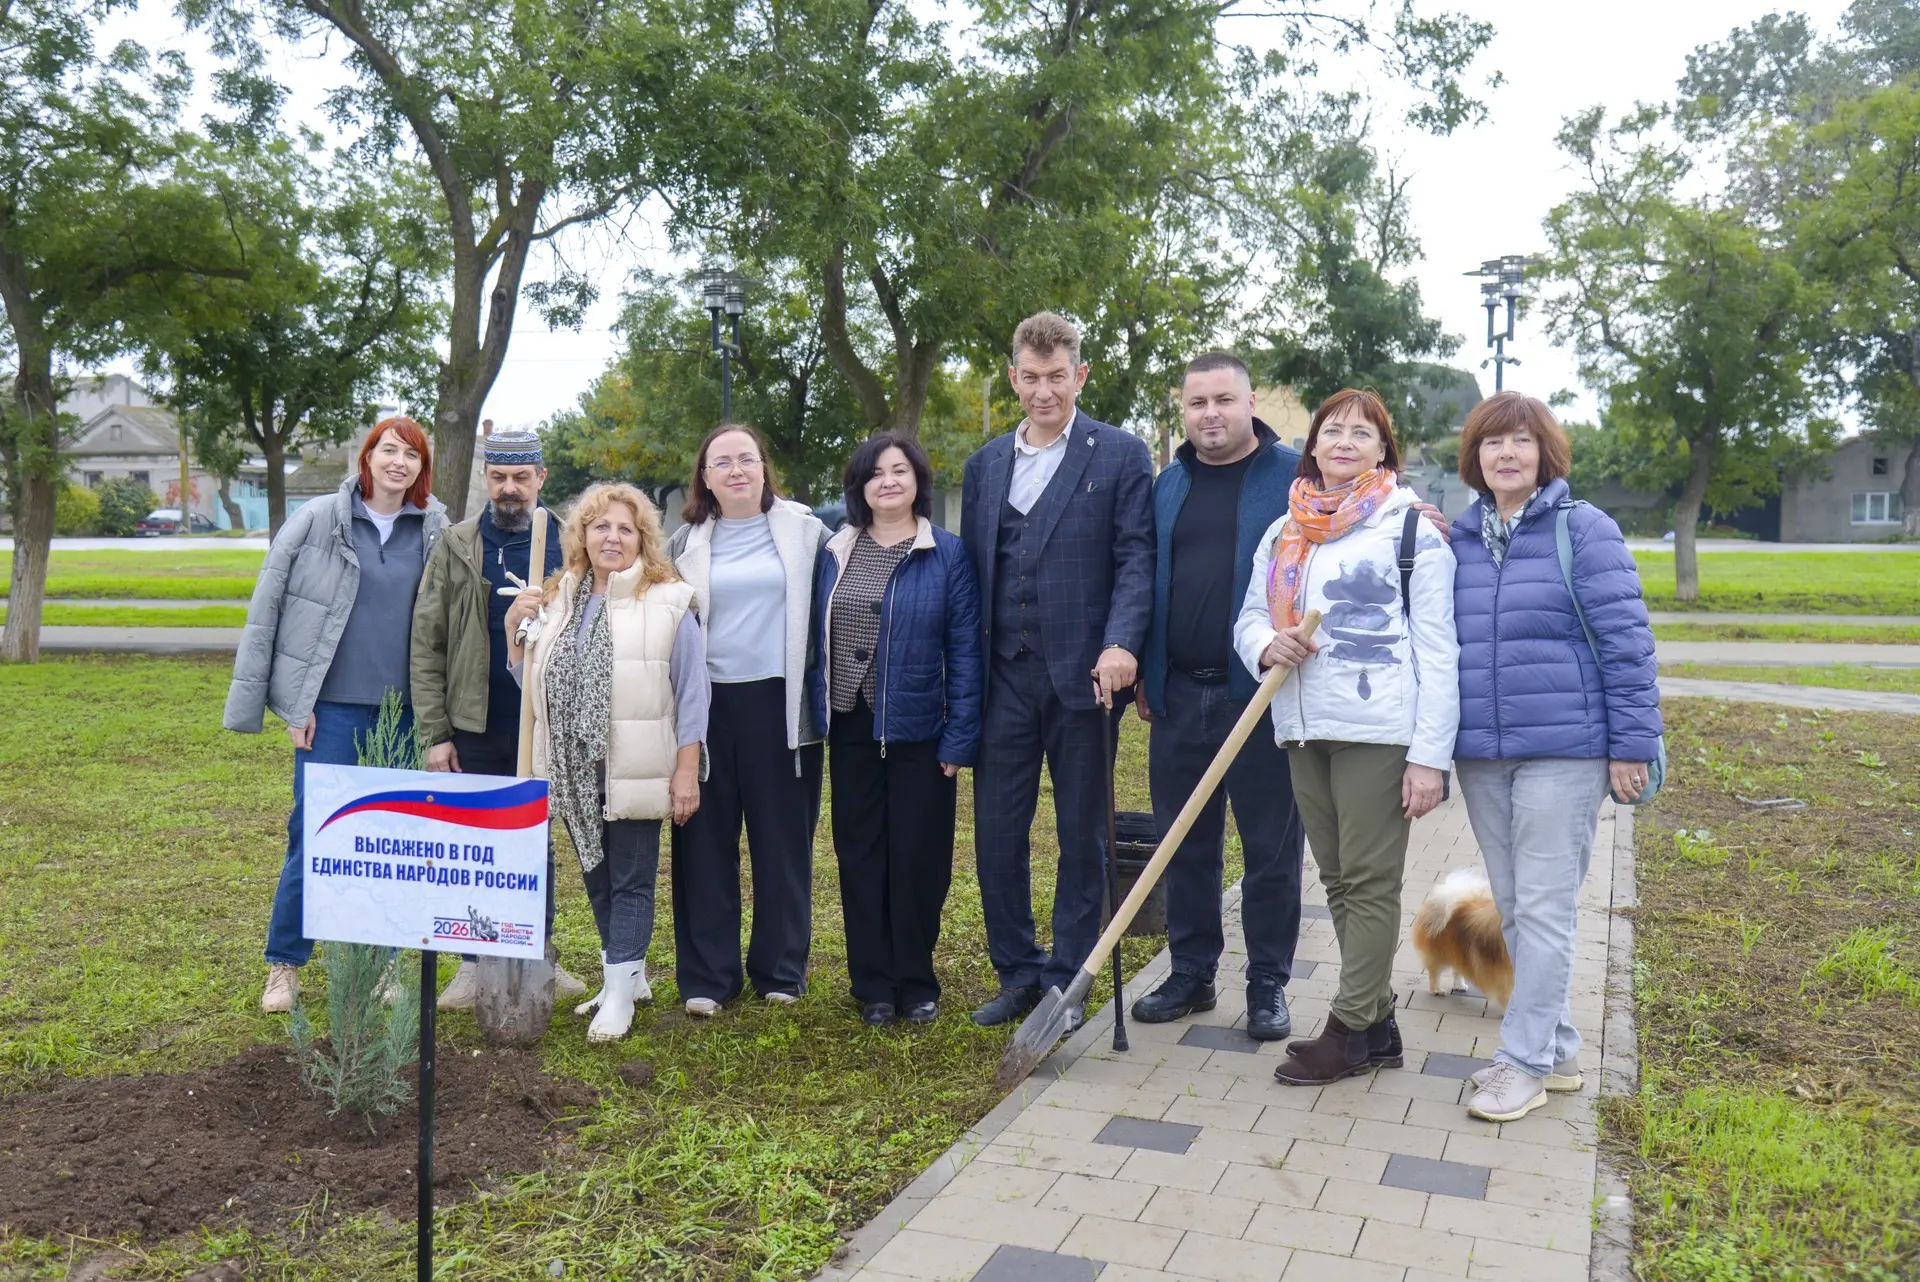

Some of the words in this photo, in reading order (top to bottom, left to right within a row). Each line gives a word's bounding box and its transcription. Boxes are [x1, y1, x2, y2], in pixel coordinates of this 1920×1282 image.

[355, 836, 445, 858] ВЫСАЖЕНО
[449, 844, 459, 860] В
[463, 844, 495, 865] ГОД
[312, 857, 393, 880] ЕДИНСТВА
[396, 864, 470, 887] НАРОДОВ
[475, 872, 538, 891] РОССИИ
[433, 920, 469, 936] 2026
